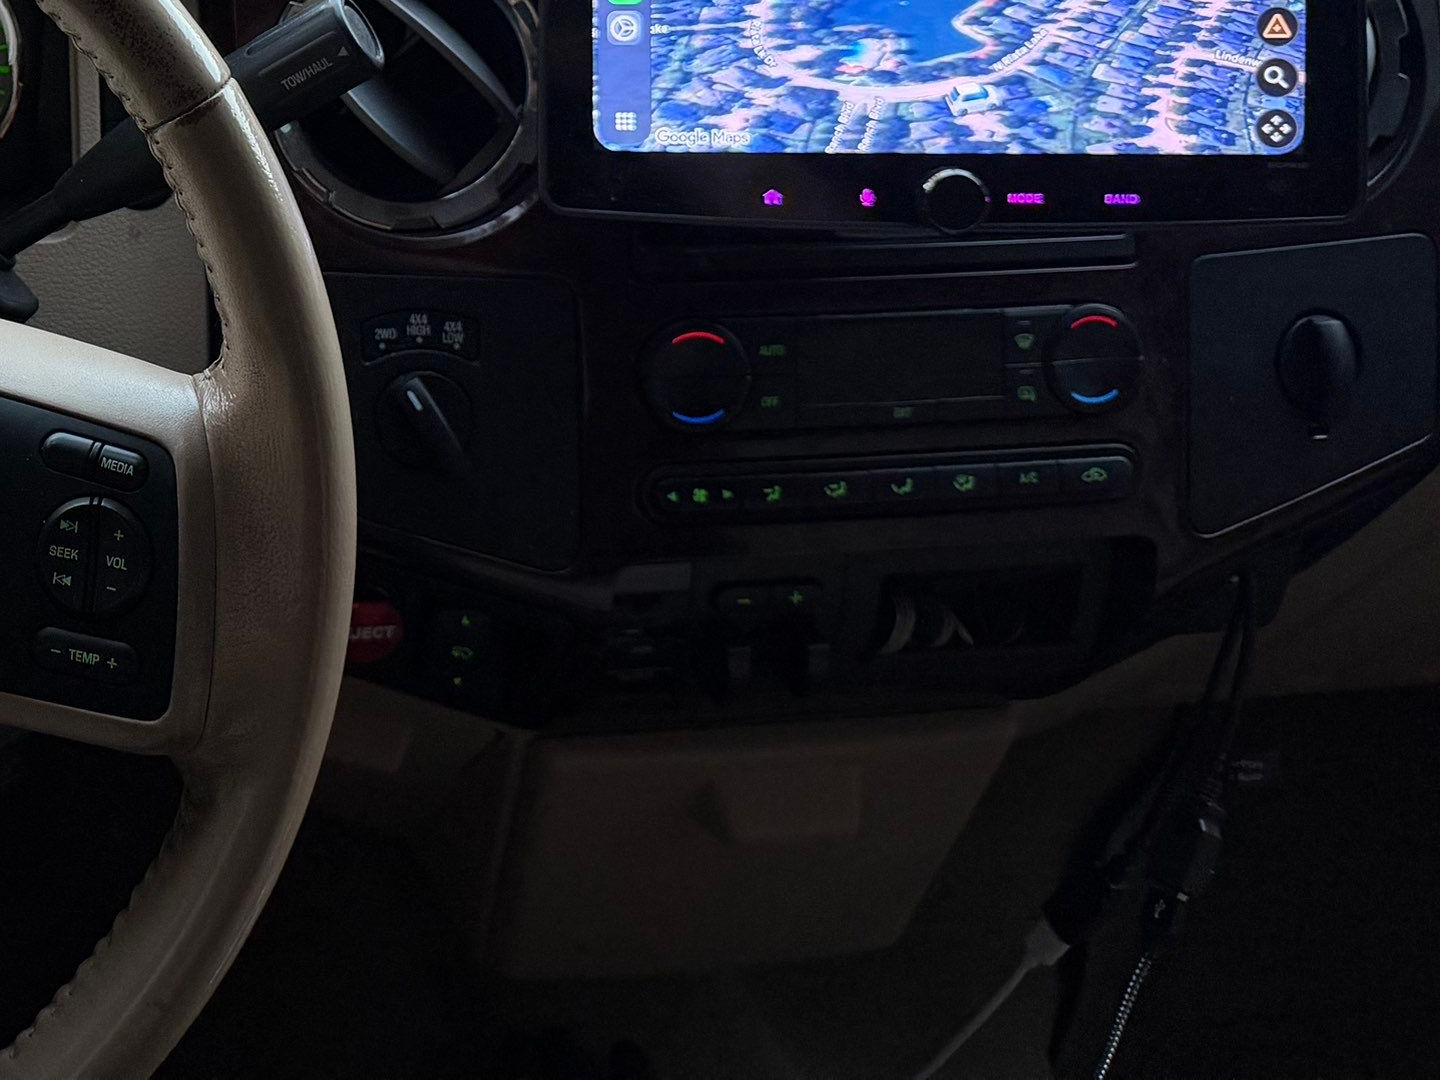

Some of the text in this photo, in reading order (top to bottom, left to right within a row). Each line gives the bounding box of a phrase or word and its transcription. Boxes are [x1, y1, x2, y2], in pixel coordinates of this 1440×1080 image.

[1023, 29, 1048, 49] Lake
[280, 57, 335, 91] TOW/HAUL
[837, 100, 855, 124] Blvd
[857, 96, 885, 151] Ranch Blvd
[655, 128, 751, 147] Google Maps
[1007, 193, 1045, 204] MODE
[1104, 193, 1141, 205] BAND
[374, 327, 397, 340] 2WD
[406, 324, 431, 337] HIGH
[442, 331, 464, 345] LOW
[100, 456, 134, 477] MEDIA
[49, 545, 79, 561] SEEK
[106, 555, 128, 571] VOL
[68, 647, 101, 666] TEMP
